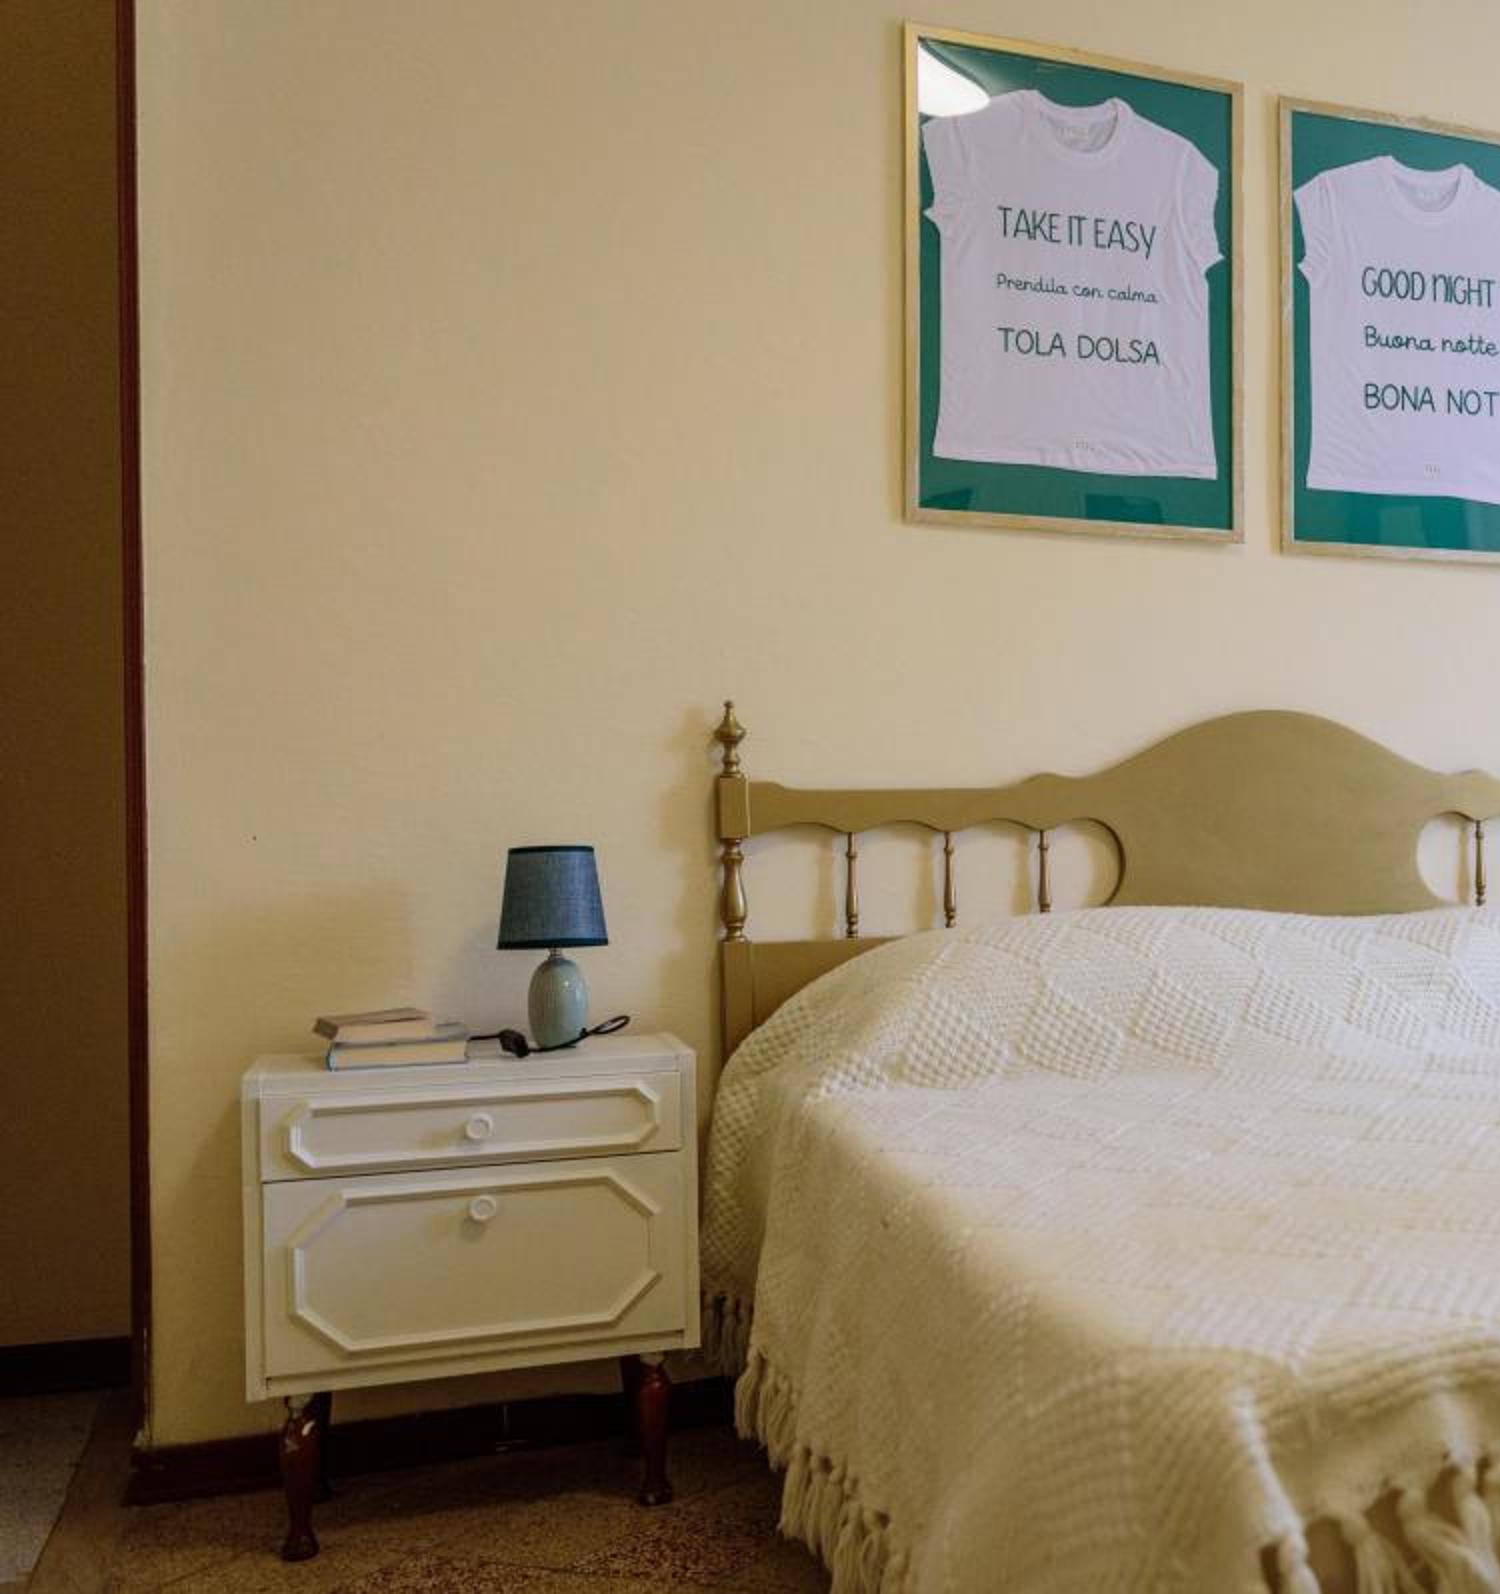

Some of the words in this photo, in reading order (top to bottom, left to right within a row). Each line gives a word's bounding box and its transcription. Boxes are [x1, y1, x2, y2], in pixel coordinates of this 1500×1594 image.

[996, 205, 1062, 244] TAKE
[1067, 215, 1088, 247] IT
[1094, 217, 1157, 261] EASY
[996, 272, 1069, 295] Prendila
[1072, 284, 1104, 299] con
[1107, 283, 1158, 304] calma
[1361, 266, 1426, 302] GOOD
[996, 326, 1067, 358] TOLA
[1077, 334, 1161, 365] DOLSA
[1364, 324, 1436, 352] Buona
[1441, 332, 1500, 357] notte
[1364, 382, 1437, 413] BONA
[1446, 387, 1500, 417] NOT
